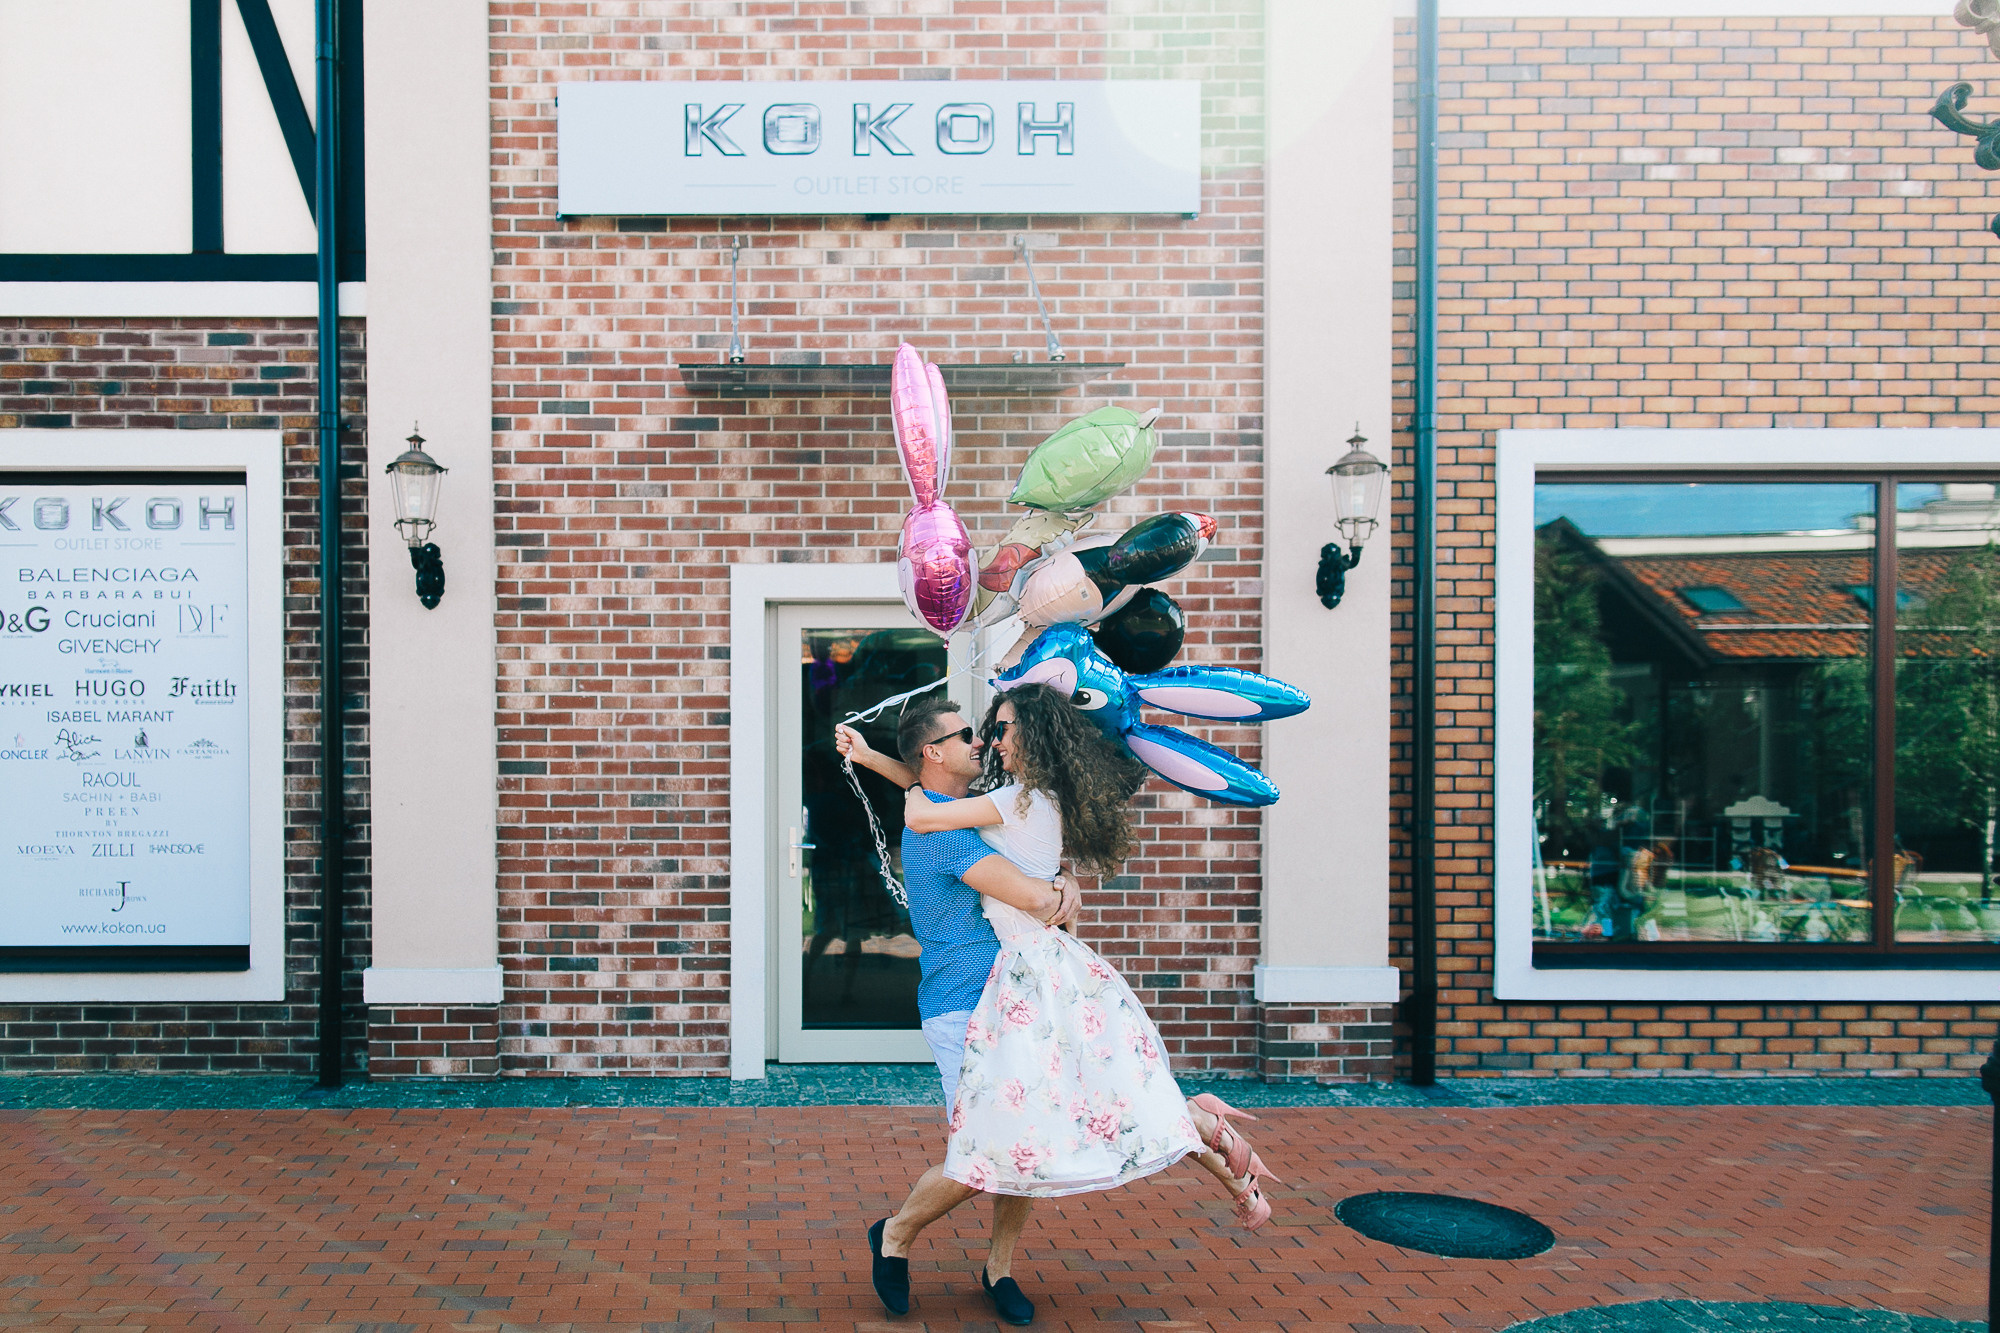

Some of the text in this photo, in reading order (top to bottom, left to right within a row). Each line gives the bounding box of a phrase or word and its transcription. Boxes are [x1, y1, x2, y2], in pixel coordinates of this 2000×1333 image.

[793, 175, 964, 196] OUTLET STORE
[54, 537, 162, 551] OUTLET STORE
[19, 568, 198, 582] BALENCIAGA
[28, 590, 191, 599] BARBARA BUI
[0, 606, 50, 633] &G
[64, 610, 155, 628] Cruciani
[58, 639, 161, 654] GIVENCHY
[76, 680, 144, 697] HUGO
[167, 677, 236, 699] Faith
[47, 710, 174, 723] ISABEL MARANT
[115, 748, 169, 760] LANVIN
[83, 772, 141, 787] RAOUL
[63, 792, 112, 803] SACHIN
[130, 792, 161, 802] BABI
[85, 807, 138, 816] PREEN
[105, 820, 118, 828] BY
[18, 845, 74, 854] MOEVA
[92, 843, 134, 857] ZILLI
[78, 887, 121, 898] RICHARD
[61, 922, 166, 934] www.kokon.ua
